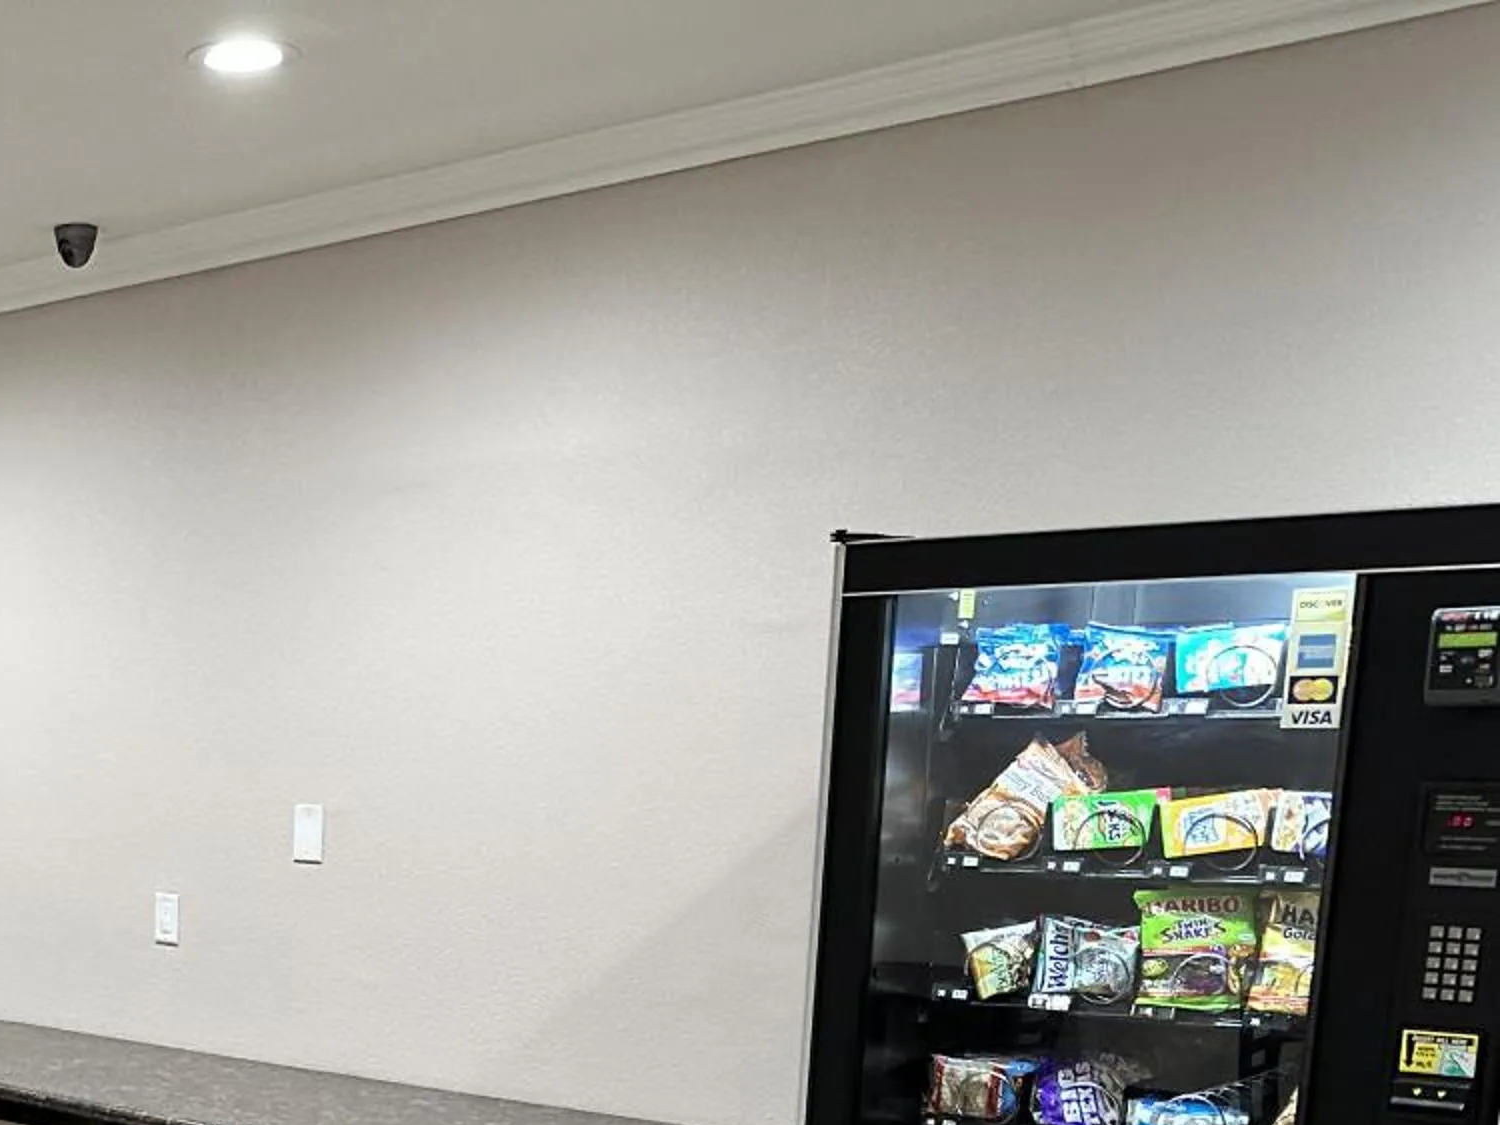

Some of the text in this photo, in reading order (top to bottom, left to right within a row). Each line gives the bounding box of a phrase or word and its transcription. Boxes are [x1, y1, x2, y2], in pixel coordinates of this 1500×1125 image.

[1299, 599, 1343, 609] DISCVER
[1291, 711, 1333, 725] VISA
[1057, 1068, 1083, 1124] BIG
